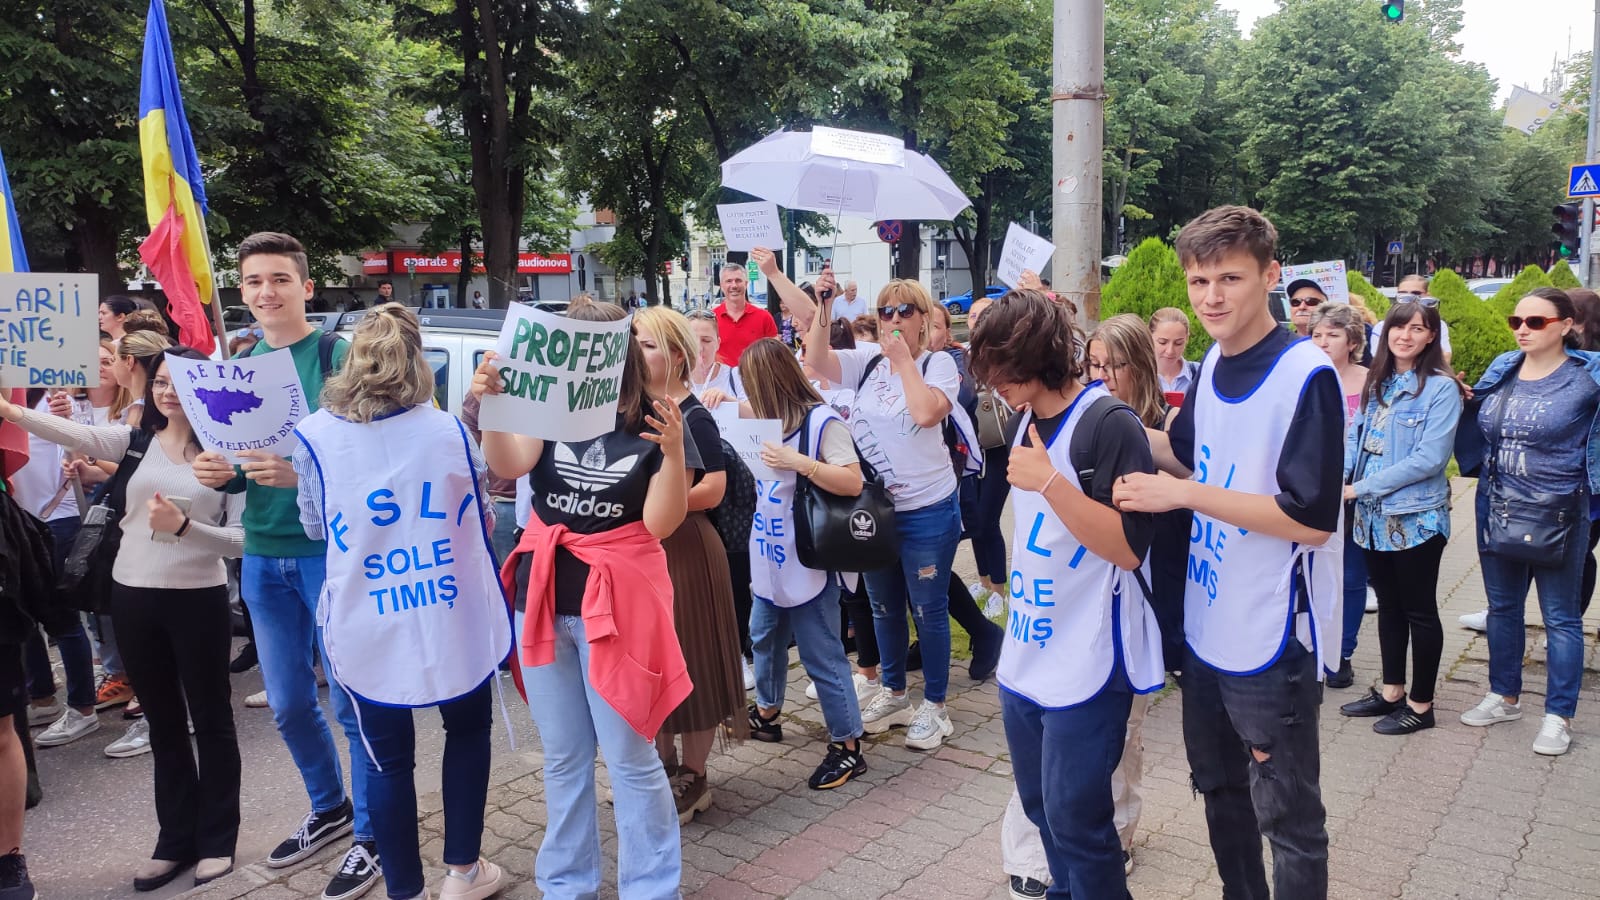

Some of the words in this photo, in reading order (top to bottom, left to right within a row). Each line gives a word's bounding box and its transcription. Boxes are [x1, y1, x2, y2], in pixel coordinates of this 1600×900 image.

[518, 257, 568, 267] audionova
[29, 364, 87, 386] DEMNĂ
[499, 366, 557, 402] SUNT
[226, 434, 279, 450] ELEVILOR
[277, 420, 295, 438] DIN
[546, 491, 624, 518] adidas
[1190, 515, 1227, 562] OLE
[363, 538, 454, 580] SOLE
[369, 575, 458, 615] TIMIȘ
